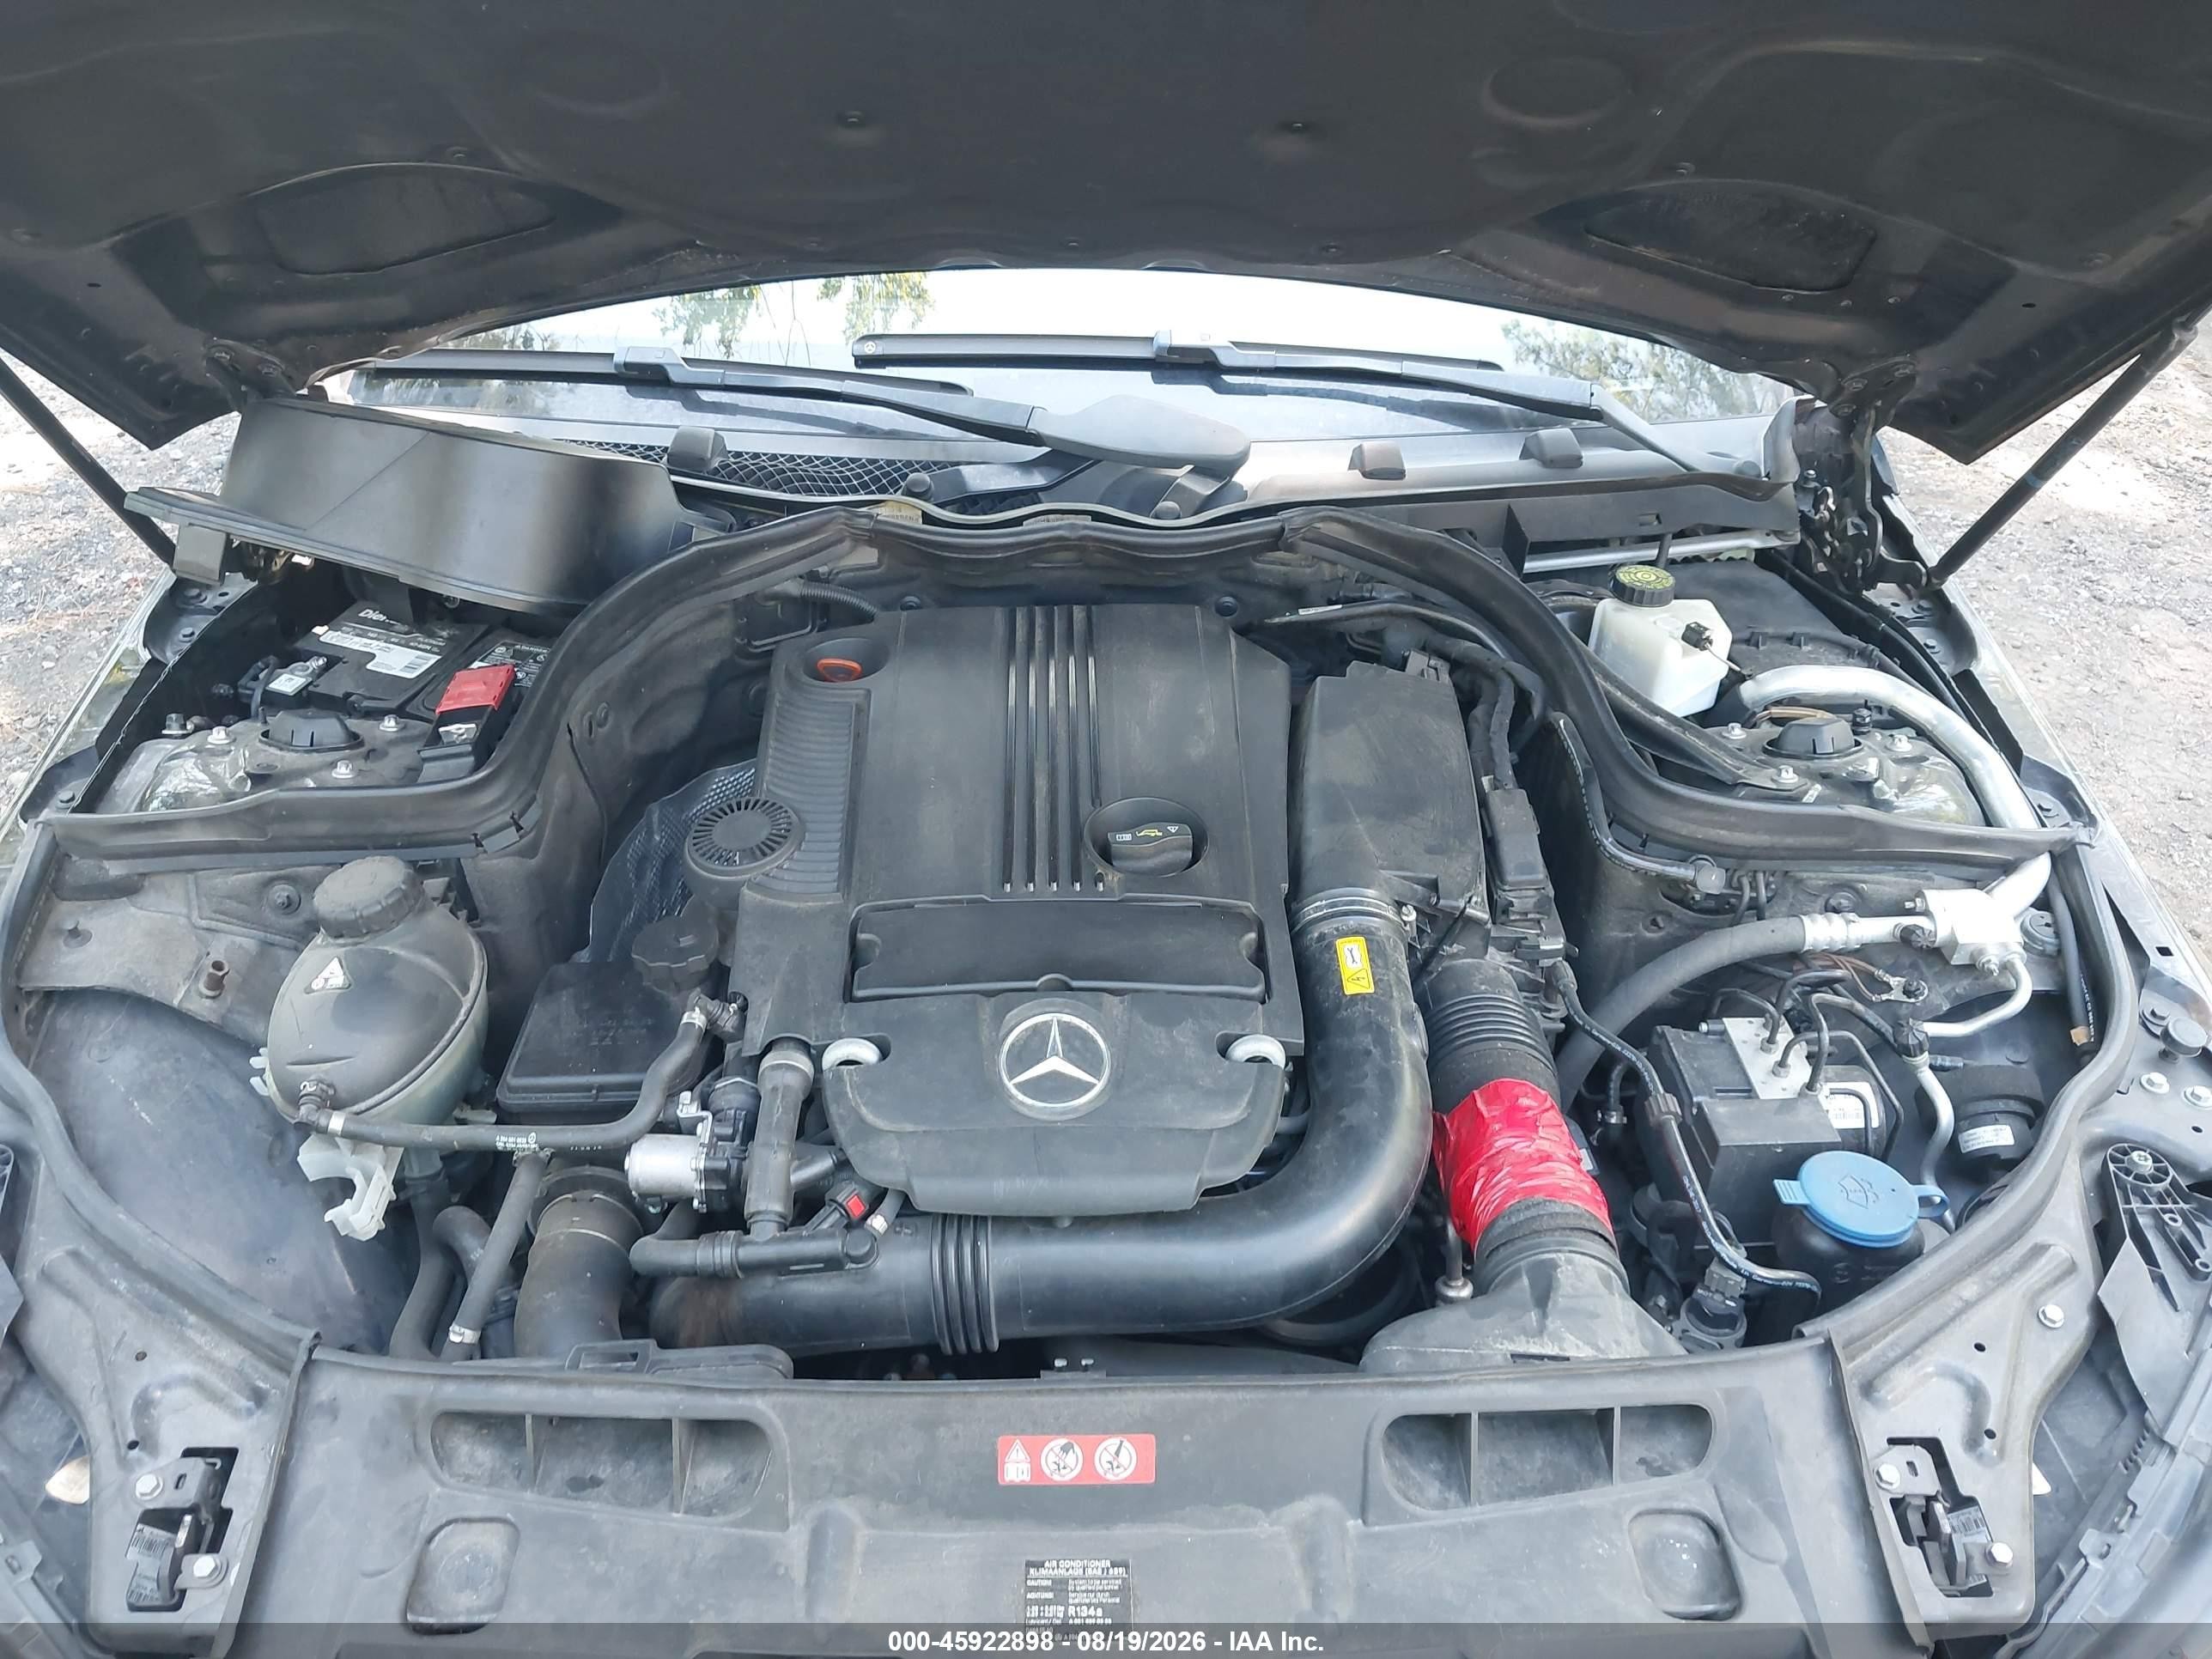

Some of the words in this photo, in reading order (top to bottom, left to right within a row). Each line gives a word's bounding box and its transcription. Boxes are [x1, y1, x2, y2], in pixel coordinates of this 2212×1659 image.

[1044, 1559, 1056, 1568] AIR
[1059, 1559, 1111, 1568] CONDITIONER
[1068, 1605, 1103, 1618] R134a
